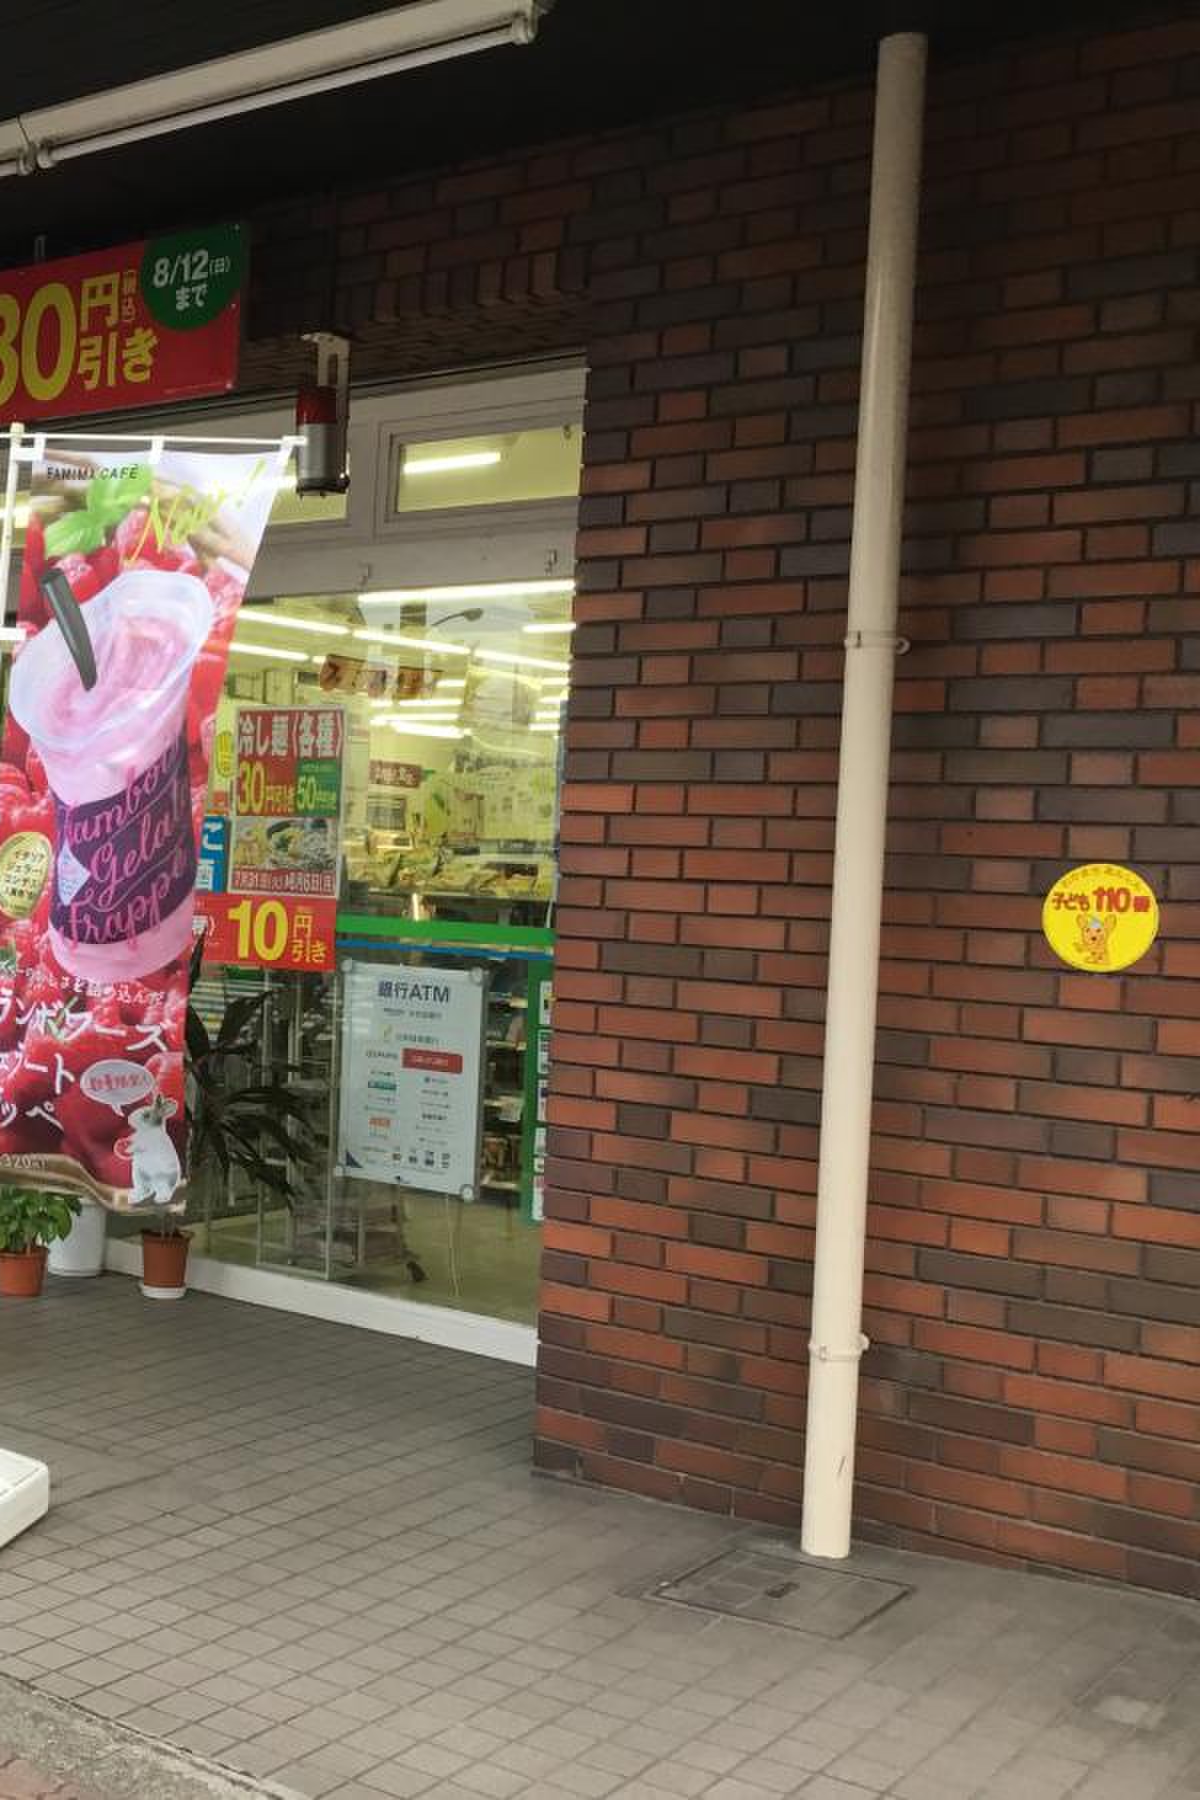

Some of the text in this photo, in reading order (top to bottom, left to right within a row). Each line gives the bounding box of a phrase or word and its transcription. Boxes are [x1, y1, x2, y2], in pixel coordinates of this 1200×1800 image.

[175, 284, 208, 311] まで
[100, 464, 140, 481] CAFÉ
[227, 899, 289, 961] 10
